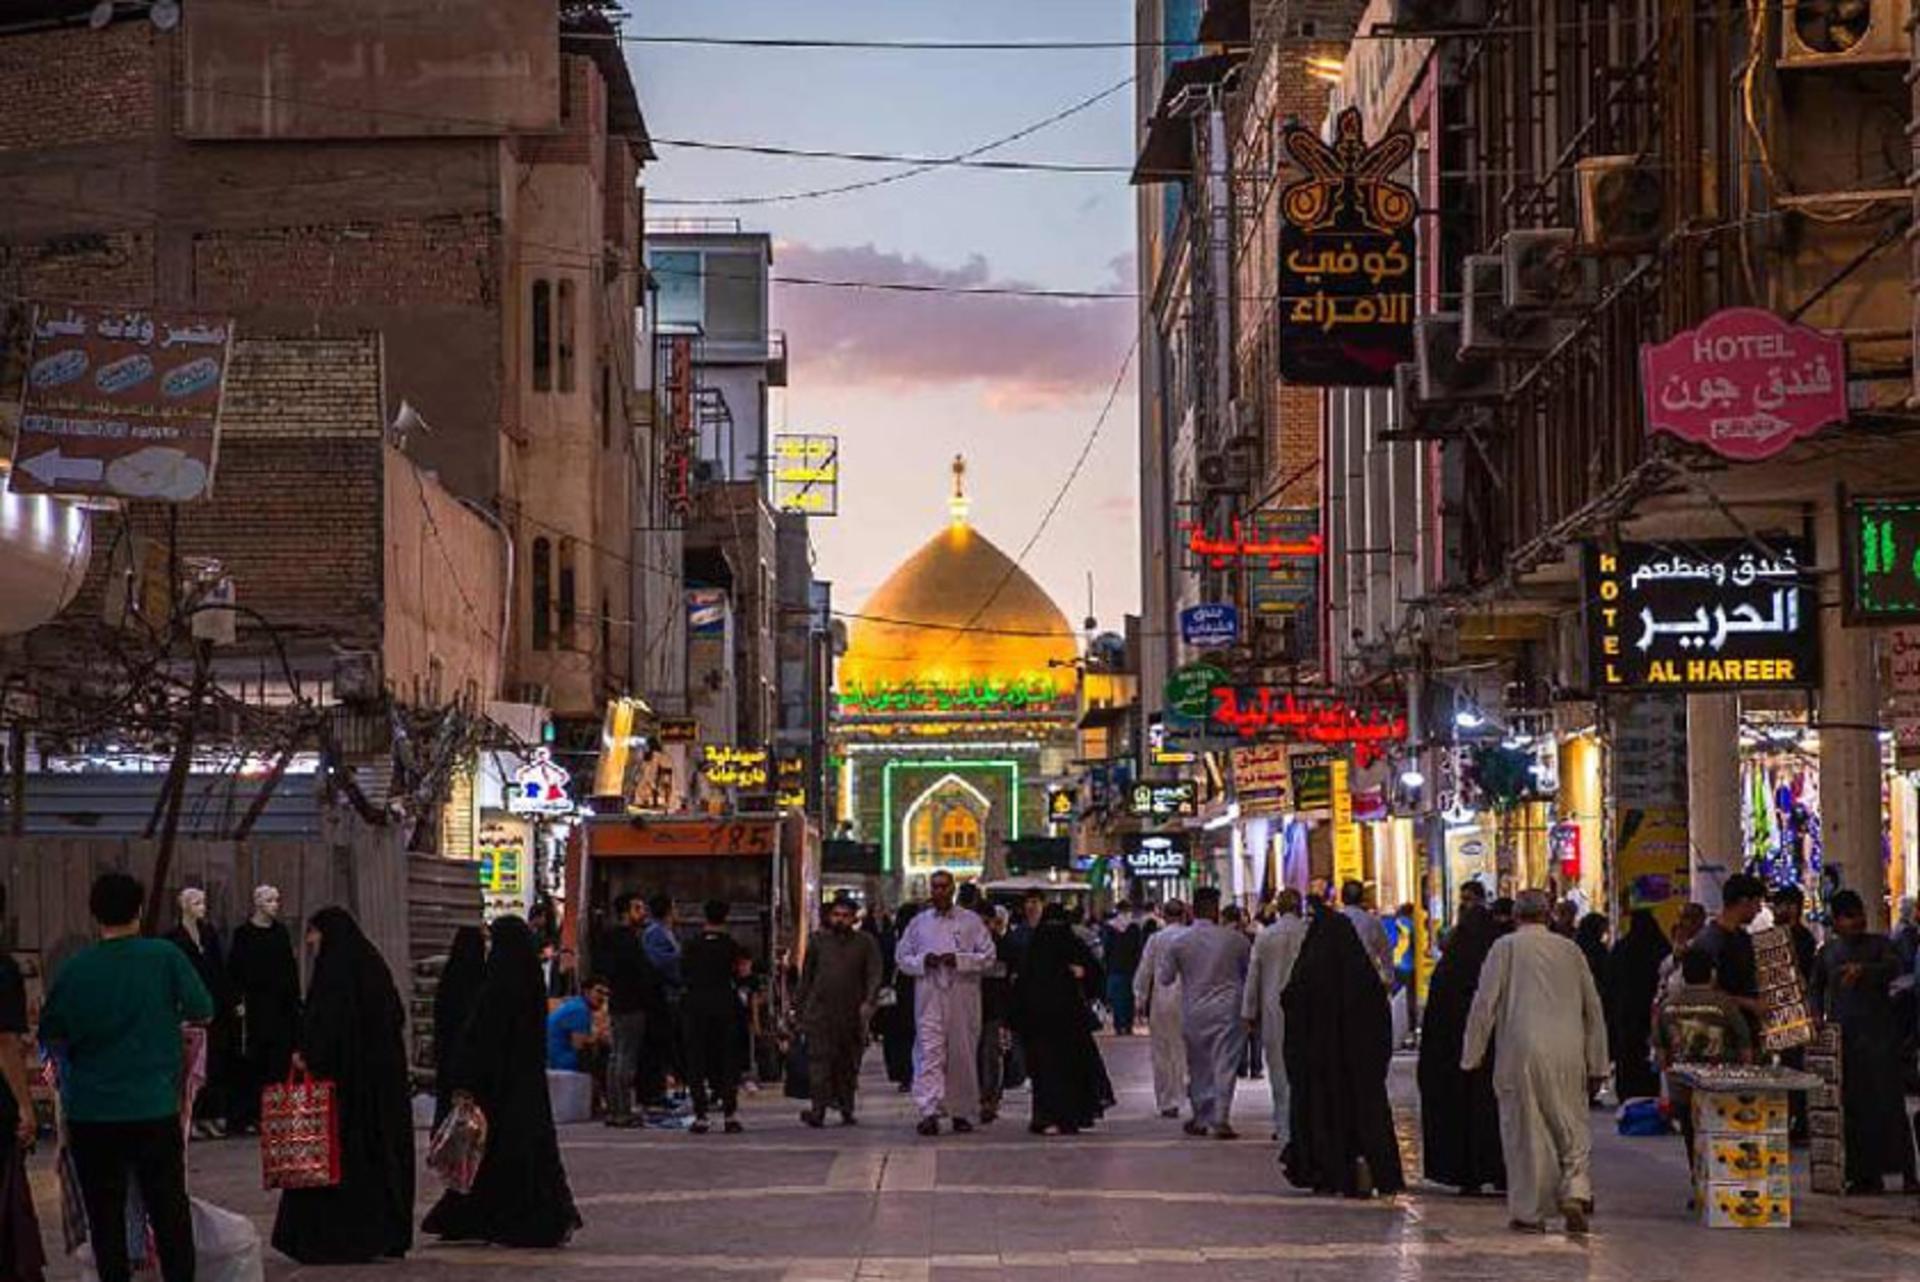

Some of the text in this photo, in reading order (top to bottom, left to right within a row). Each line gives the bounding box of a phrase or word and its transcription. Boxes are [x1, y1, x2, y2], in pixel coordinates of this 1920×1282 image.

[1287, 240, 1408, 285] كوفي
[1693, 333, 1796, 363] HOTEL
[1753, 354, 1832, 410] فندق
[1630, 555, 1726, 589] ومطعم
[1600, 553, 1622, 683] HOTEL
[1635, 586, 1799, 653] الحرير
[1648, 659, 1794, 683] AL HAREER
